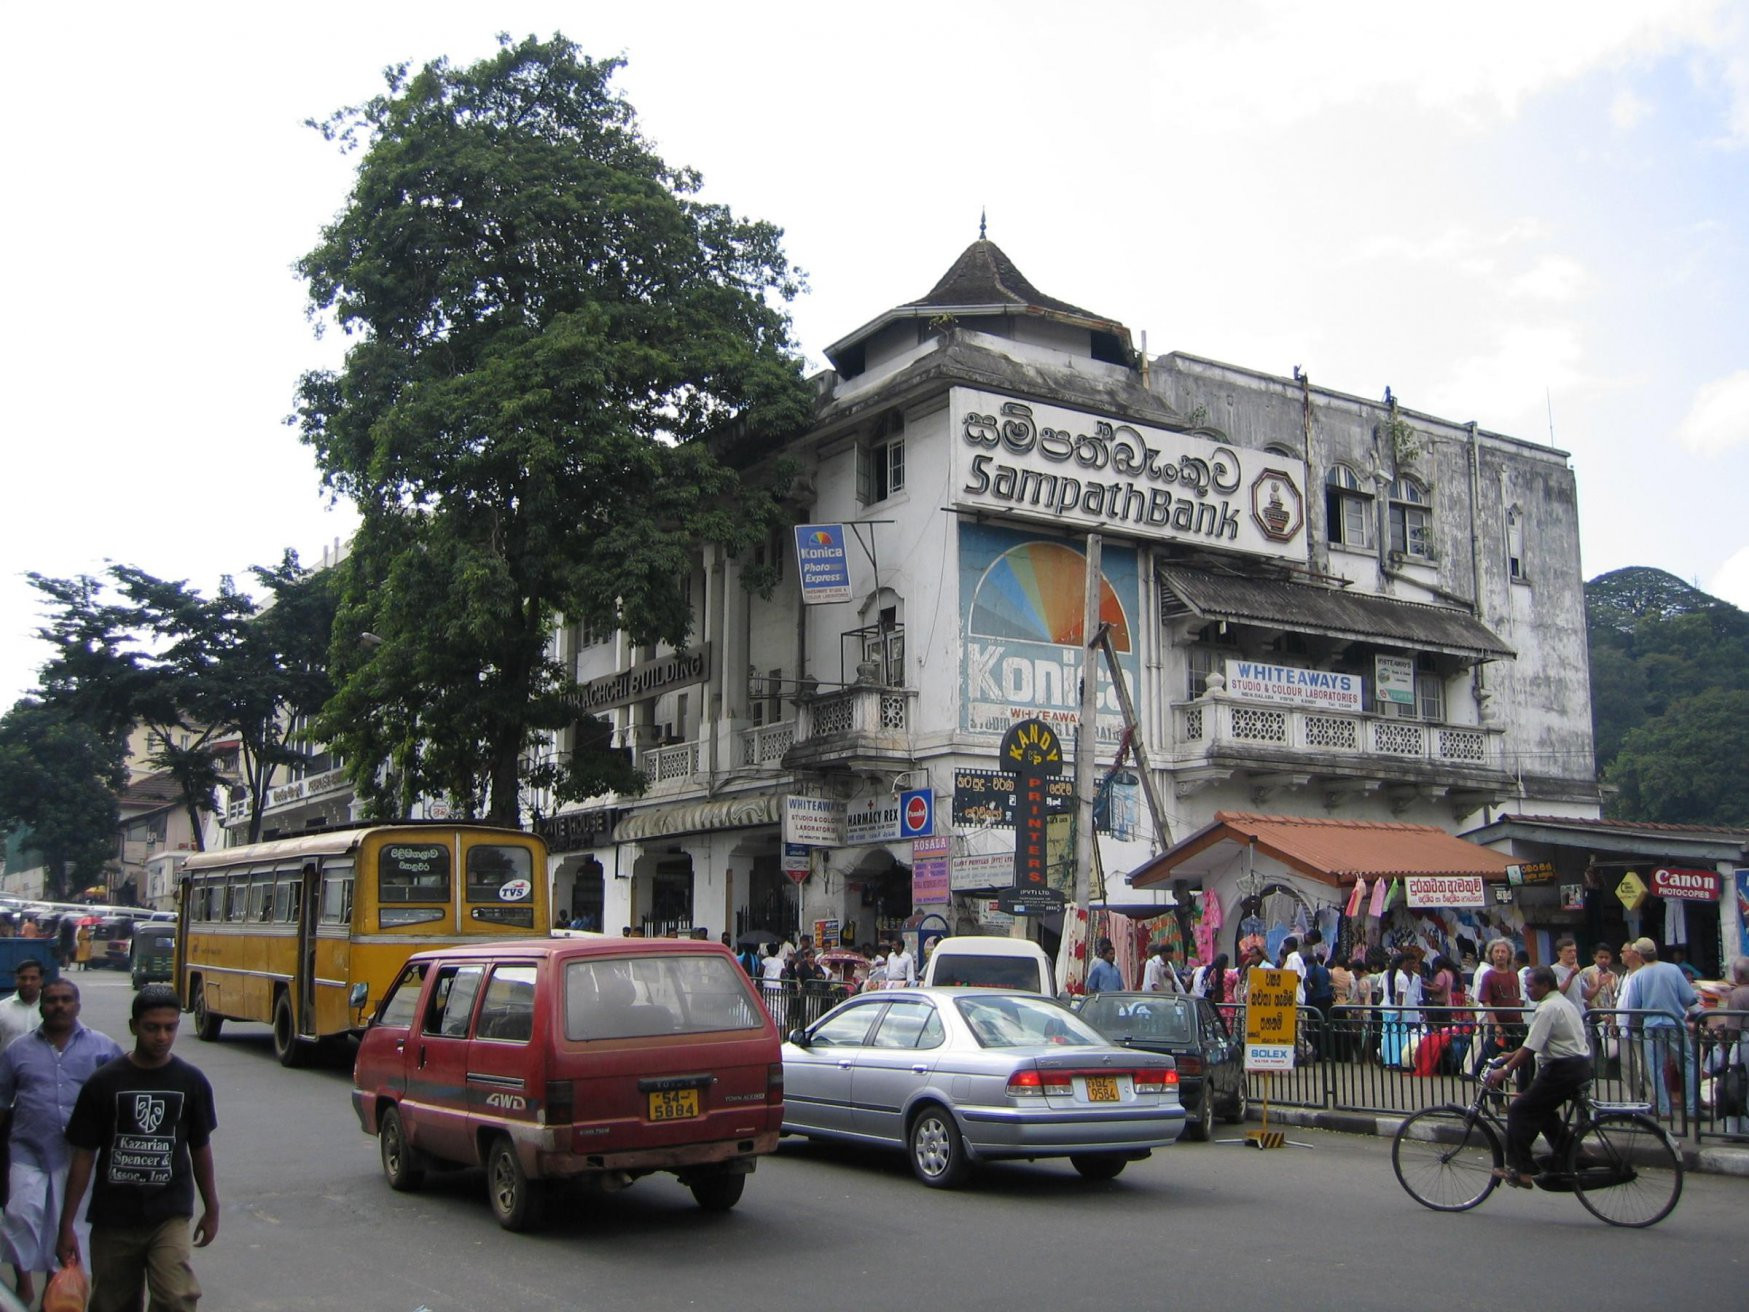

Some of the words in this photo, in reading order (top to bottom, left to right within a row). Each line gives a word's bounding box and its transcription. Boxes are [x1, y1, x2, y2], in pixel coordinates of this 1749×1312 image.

[964, 453, 1240, 540] SampathBank
[800, 547, 843, 560] Konica
[804, 562, 830, 572] Photo
[805, 573, 840, 584] Express
[631, 656, 703, 694] BUILDING
[1238, 662, 1351, 691] WHITEAWAYS
[1231, 680, 1261, 693] STUDIO
[1264, 684, 1270, 693] &
[1272, 686, 1303, 698] COLOUR
[1305, 688, 1358, 704] LABORATORIES
[1009, 723, 1059, 762] KANDY
[847, 810, 881, 827] HARMACY
[884, 808, 898, 823] REX
[1027, 778, 1044, 882] PRINTERS
[1655, 869, 1714, 889] Canon
[502, 888, 524, 897] TVS
[1658, 886, 1710, 899] PHOTOCOPIES
[486, 1092, 527, 1111] 4WD
[120, 1137, 169, 1151] Kazarian
[114, 1151, 160, 1166] Spencer
[161, 1153, 170, 1166] &
